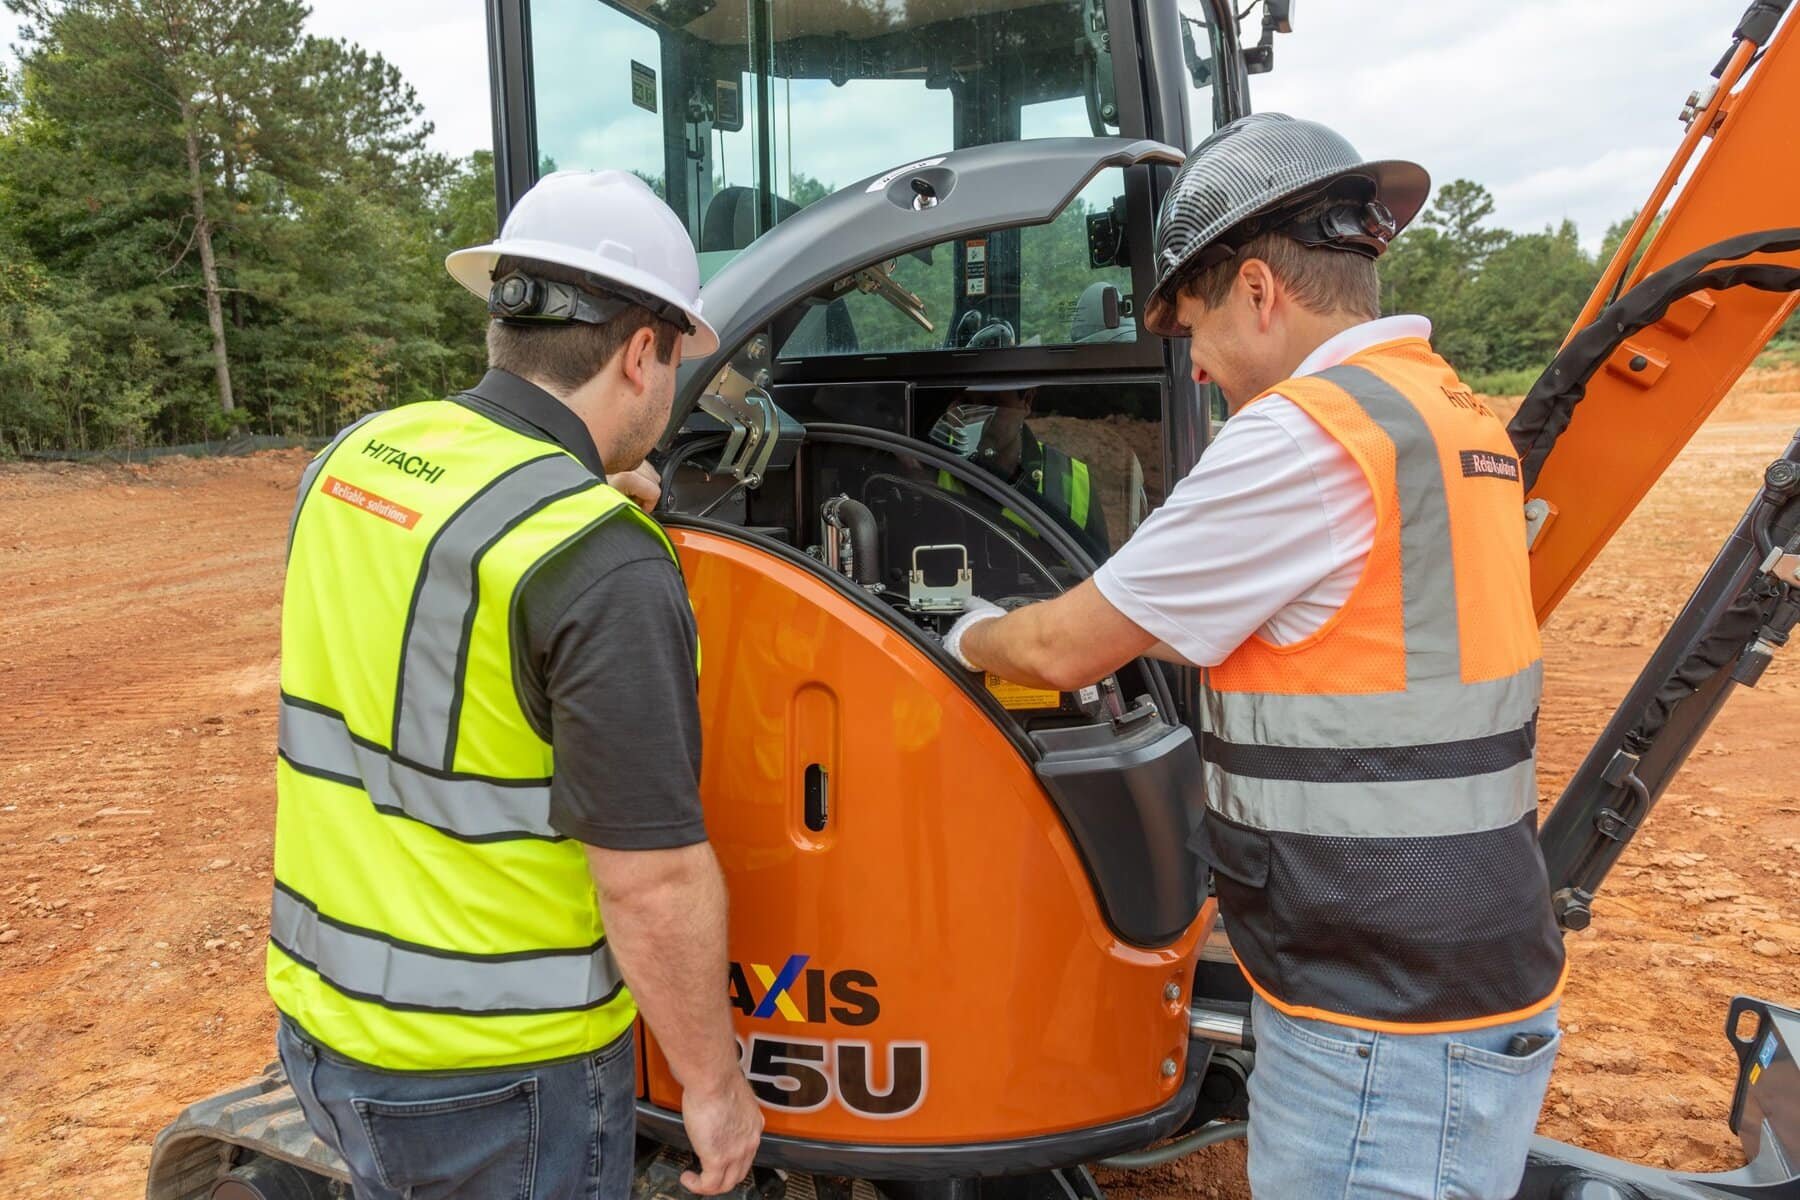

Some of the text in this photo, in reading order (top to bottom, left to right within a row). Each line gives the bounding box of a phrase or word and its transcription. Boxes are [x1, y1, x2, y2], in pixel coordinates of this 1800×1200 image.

[361, 439, 446, 484] HITACHI
[331, 481, 409, 524] Reliable solutions
[727, 954, 881, 1027] AXIS
[735, 1033, 928, 1120] 5U
